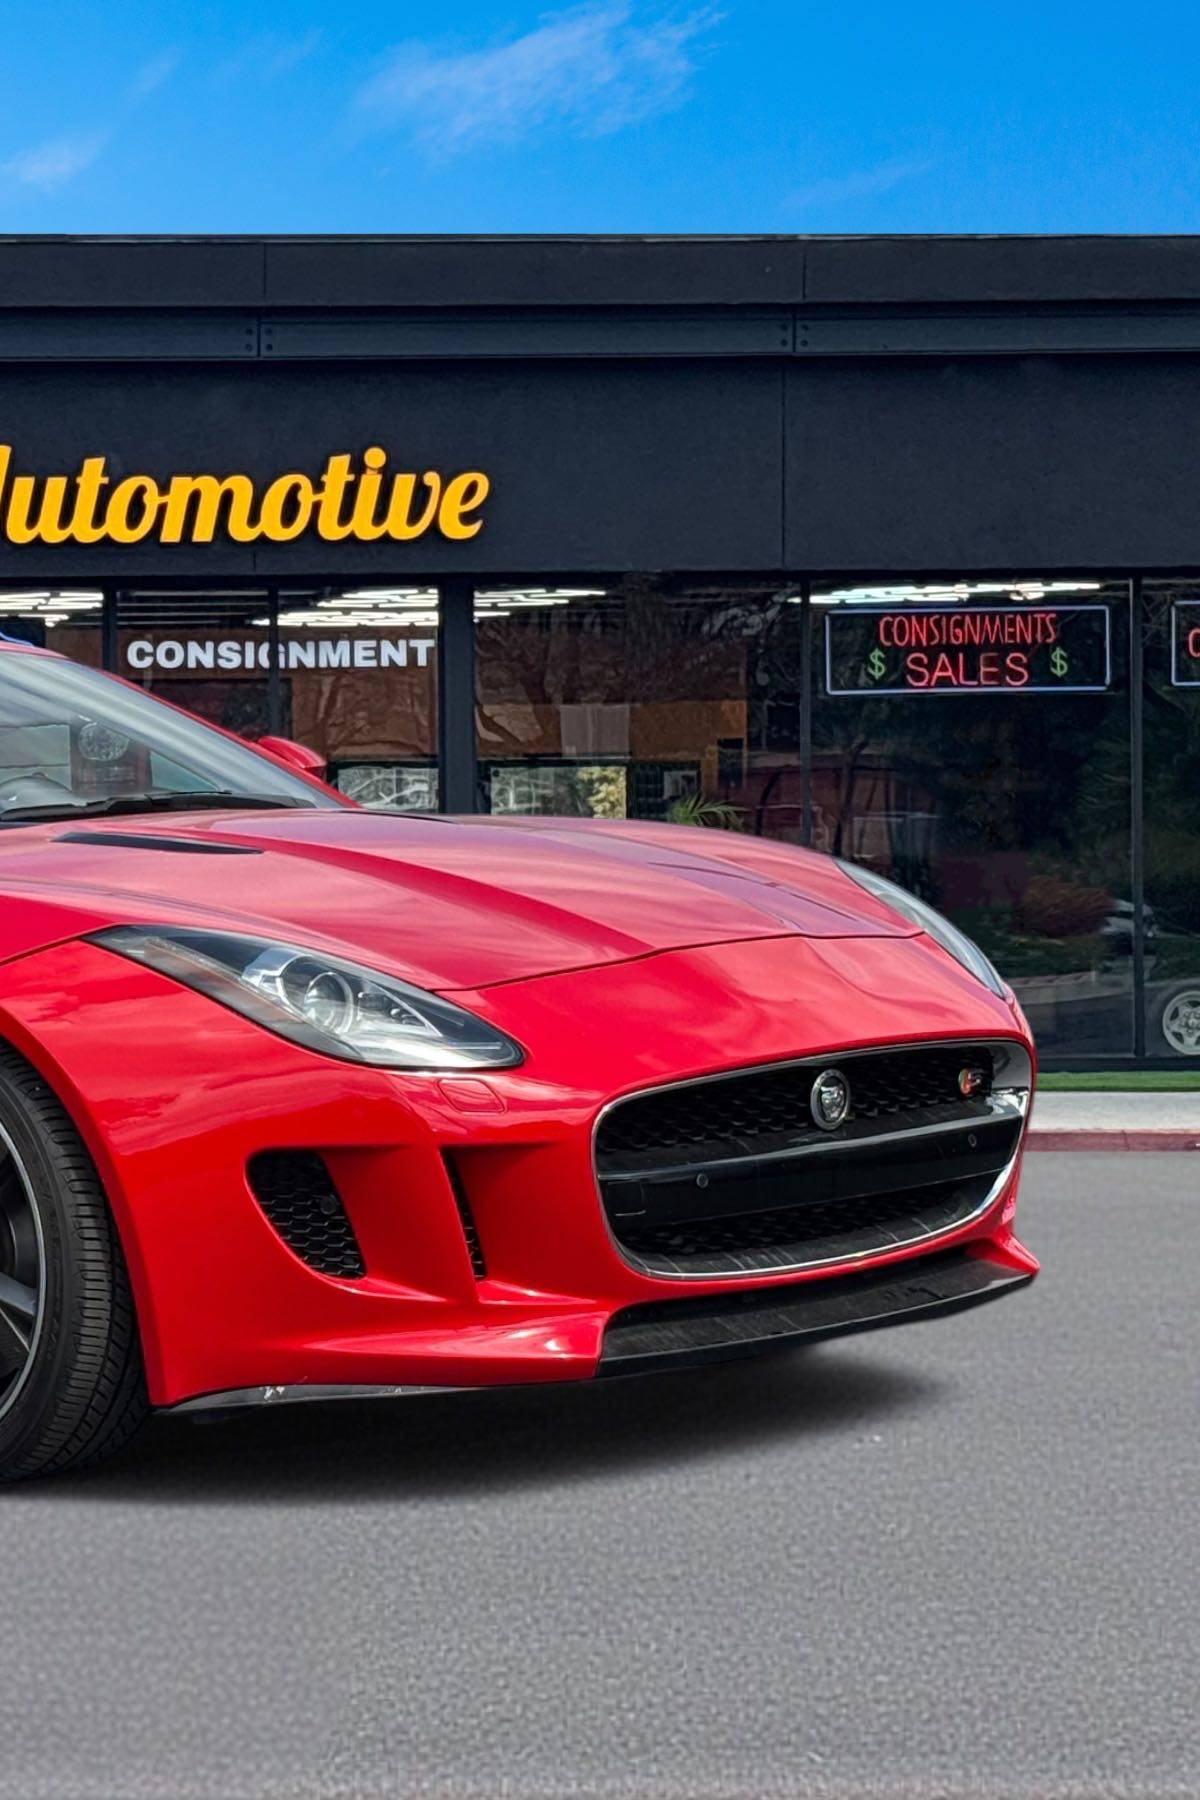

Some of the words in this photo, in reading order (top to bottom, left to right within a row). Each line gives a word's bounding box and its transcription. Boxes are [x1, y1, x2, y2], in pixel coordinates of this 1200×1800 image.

[878, 613, 1058, 647] CONSIGNMENTS
[126, 638, 436, 670] CONSIGNMENT
[866, 647, 887, 681] $
[905, 652, 1030, 687] SALES
[1050, 646, 1069, 678] $
